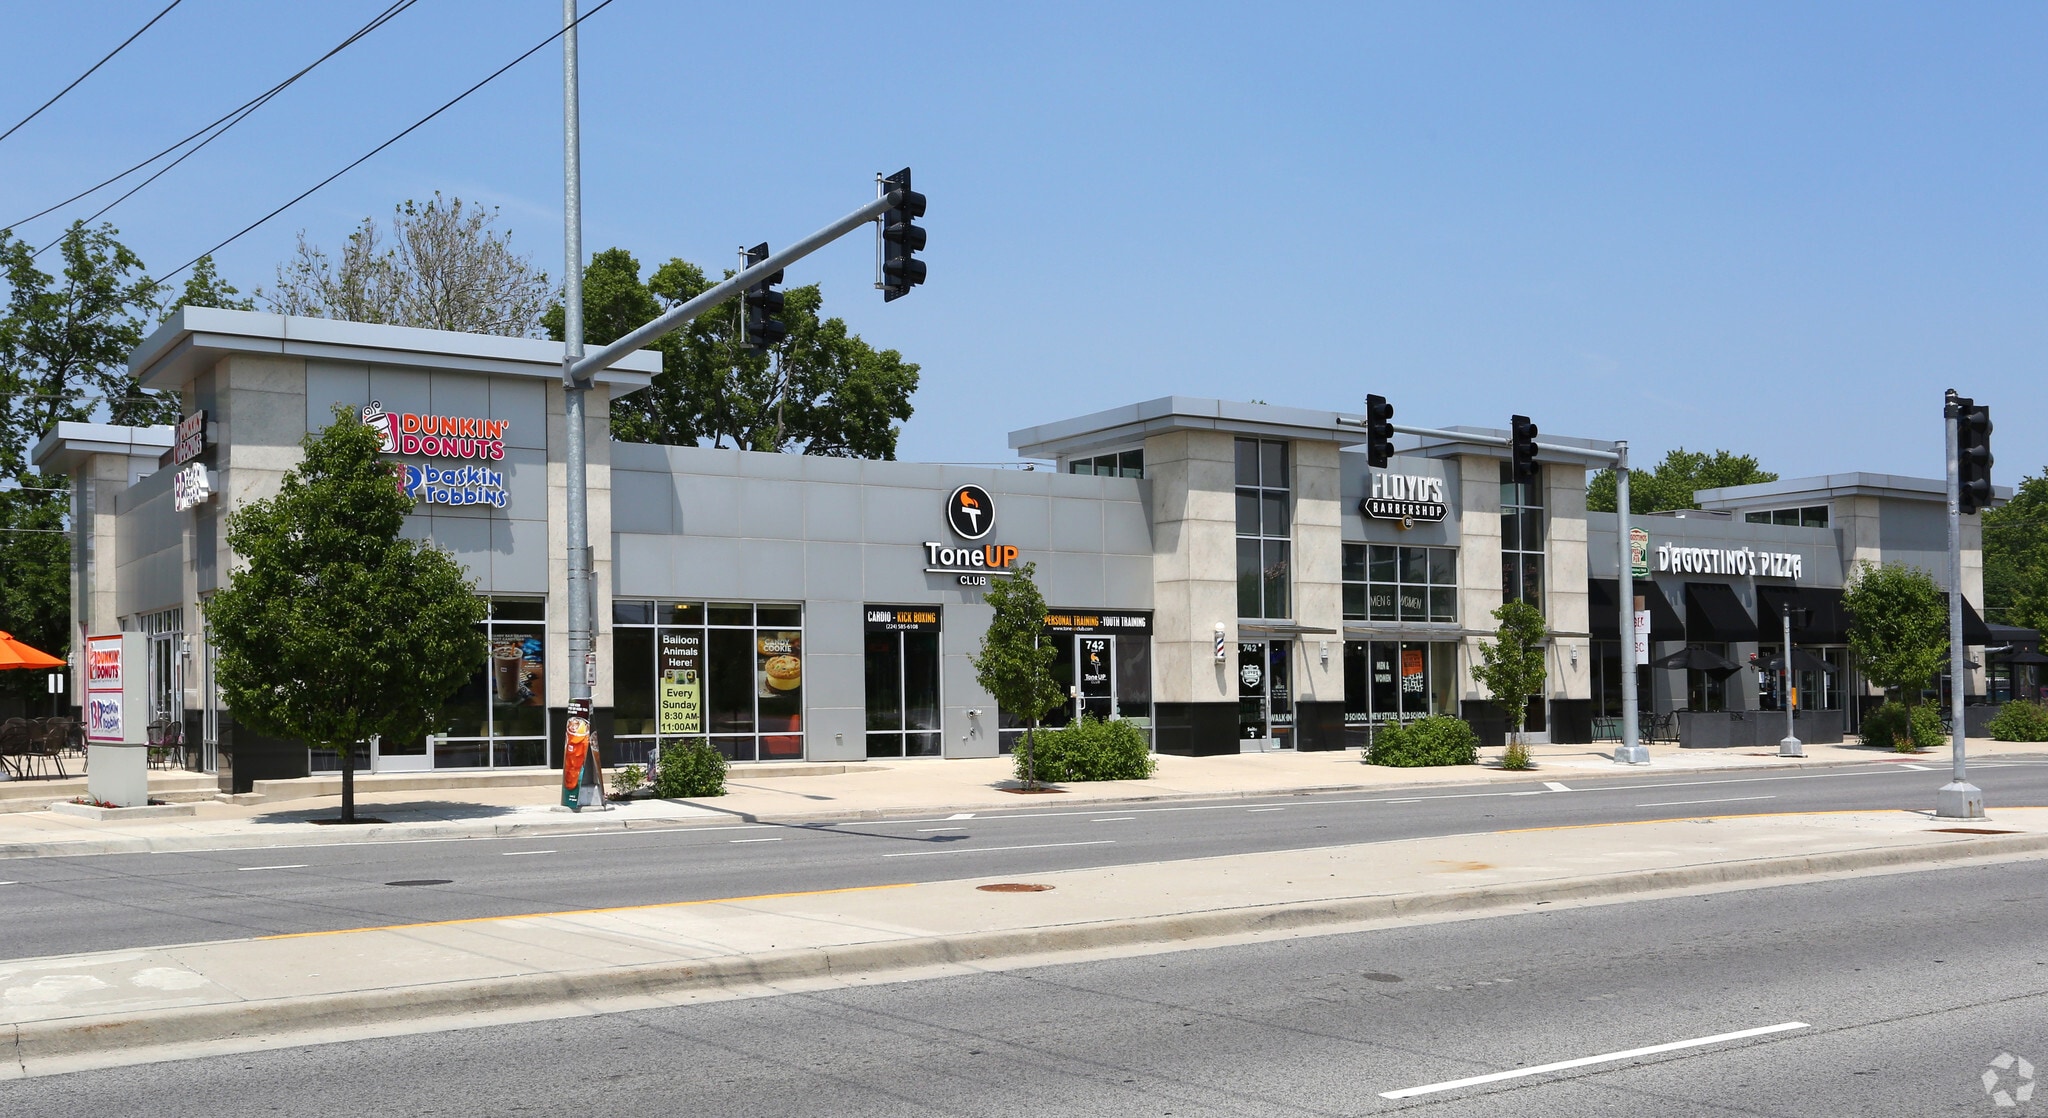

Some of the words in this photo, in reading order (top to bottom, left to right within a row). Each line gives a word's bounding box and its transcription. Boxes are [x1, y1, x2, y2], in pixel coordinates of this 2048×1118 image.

[403, 413, 509, 439] DUNKIN'
[403, 435, 505, 460] DONUTS
[424, 465, 502, 488] baskin
[1371, 473, 1443, 502] FLOYD'S
[425, 486, 507, 508] robbins
[1373, 502, 1442, 517] BARBERSHOP
[925, 541, 1019, 568] ToneUP
[1657, 542, 1755, 576] D'AGOSTINO'S
[1760, 551, 1802, 580] PIZZA
[960, 575, 986, 586] CLUB
[867, 611, 892, 622] CARDIO
[897, 612, 912, 623] KICK
[913, 612, 936, 623] BOXING
[1044, 615, 1072, 626] PERSONAL
[1073, 615, 1100, 627] TRAINING
[1121, 616, 1146, 627] TRAINING
[662, 635, 699, 645] Balloon
[1085, 640, 1105, 650] 742
[663, 647, 698, 656] Animals
[1242, 644, 1257, 652] 742
[95, 650, 120, 664] DUNKIN'
[668, 658, 693, 667] Here!
[1376, 661, 1385, 670] MEN
[97, 665, 119, 679] DONUTS
[1375, 674, 1392, 682] WOMEN
[666, 688, 693, 699] Every
[662, 700, 697, 711] Sunday
[90, 700, 102, 729] BR
[664, 711, 683, 720] 8:30
[1349, 712, 1367, 721] SCHOOL
[661, 722, 698, 731] 11:00AM
